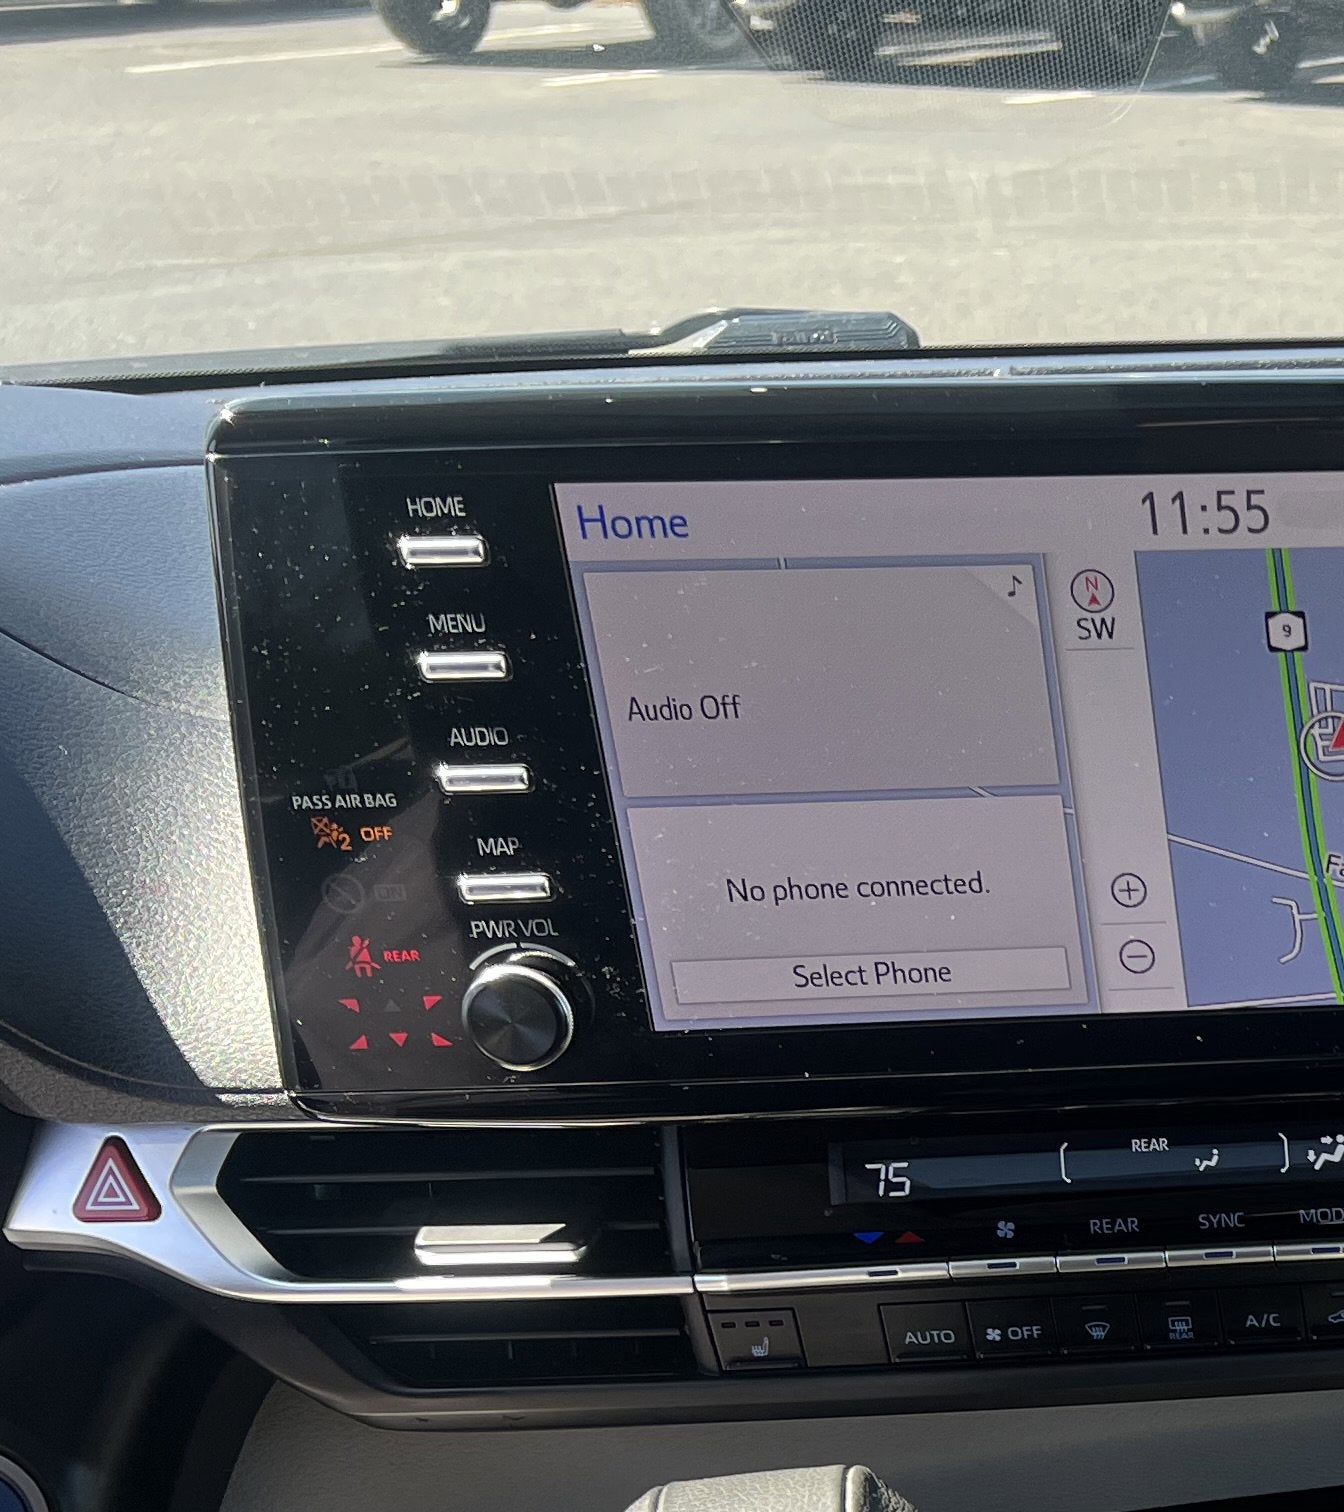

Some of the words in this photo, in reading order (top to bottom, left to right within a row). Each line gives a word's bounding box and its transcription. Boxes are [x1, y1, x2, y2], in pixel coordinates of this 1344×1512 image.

[406, 496, 467, 518] HOME
[1141, 489, 1271, 536] 11:55
[577, 505, 690, 541] Home
[428, 612, 487, 635] MENU
[1077, 616, 1116, 641] SW
[1282, 623, 1293, 639] 9
[627, 696, 694, 723] Audio
[700, 694, 742, 720] Off
[450, 726, 509, 747] AUDIO
[291, 795, 332, 811] PASS
[335, 794, 361, 809] AIR
[364, 792, 398, 809] BAG
[360, 825, 394, 843] OFF
[477, 837, 519, 856] MAP
[727, 877, 766, 903] No
[773, 876, 850, 910] phone
[856, 871, 992, 901] connected.
[469, 919, 518, 940] PWR
[520, 918, 560, 939] VOL
[383, 948, 421, 964] REAR
[792, 962, 868, 987] Select
[873, 960, 953, 986] Phone
[1131, 1137, 1170, 1154] REAR
[864, 1161, 912, 1198] 75
[1089, 1216, 1140, 1235] REAR
[1198, 1212, 1246, 1230] SYNC
[1245, 1312, 1282, 1329] A/C
[904, 1328, 956, 1346] AUTO
[1007, 1325, 1043, 1341] OFF
[1168, 1329, 1195, 1341] REAR
